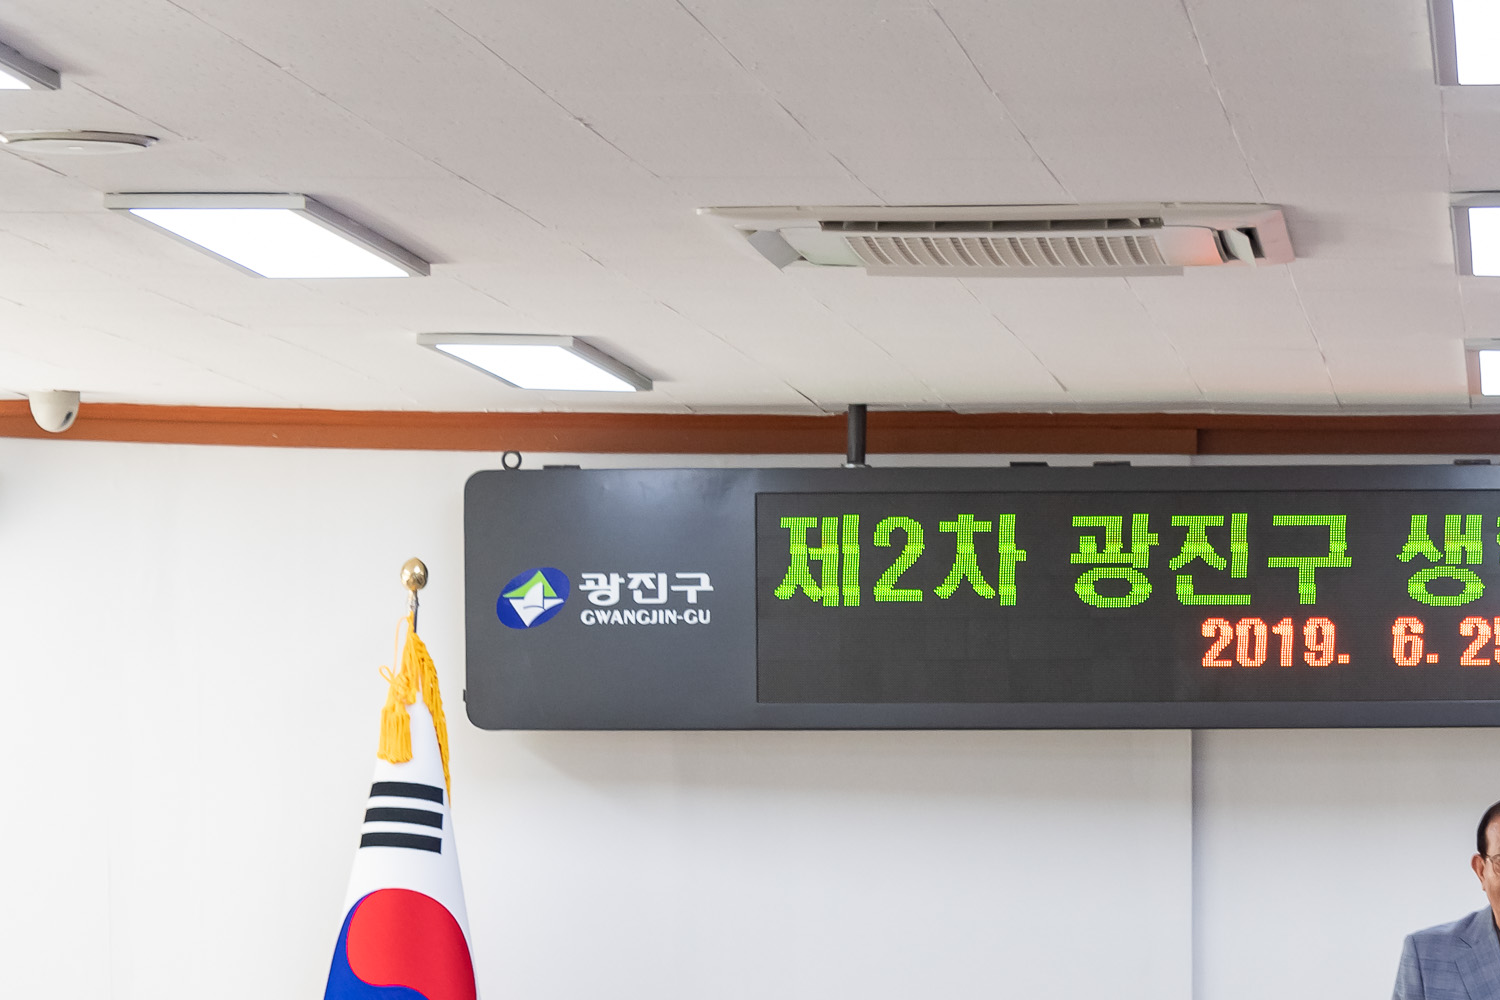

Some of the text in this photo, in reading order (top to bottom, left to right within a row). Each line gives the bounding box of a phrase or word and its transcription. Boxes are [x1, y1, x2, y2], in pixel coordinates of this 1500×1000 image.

[774, 513, 1027, 607] 제2차
[1070, 512, 1352, 609] 광진구
[578, 572, 714, 606] 광진구
[580, 609, 711, 626] GWANGJIN-GU
[1201, 616, 1351, 668] 2019.
